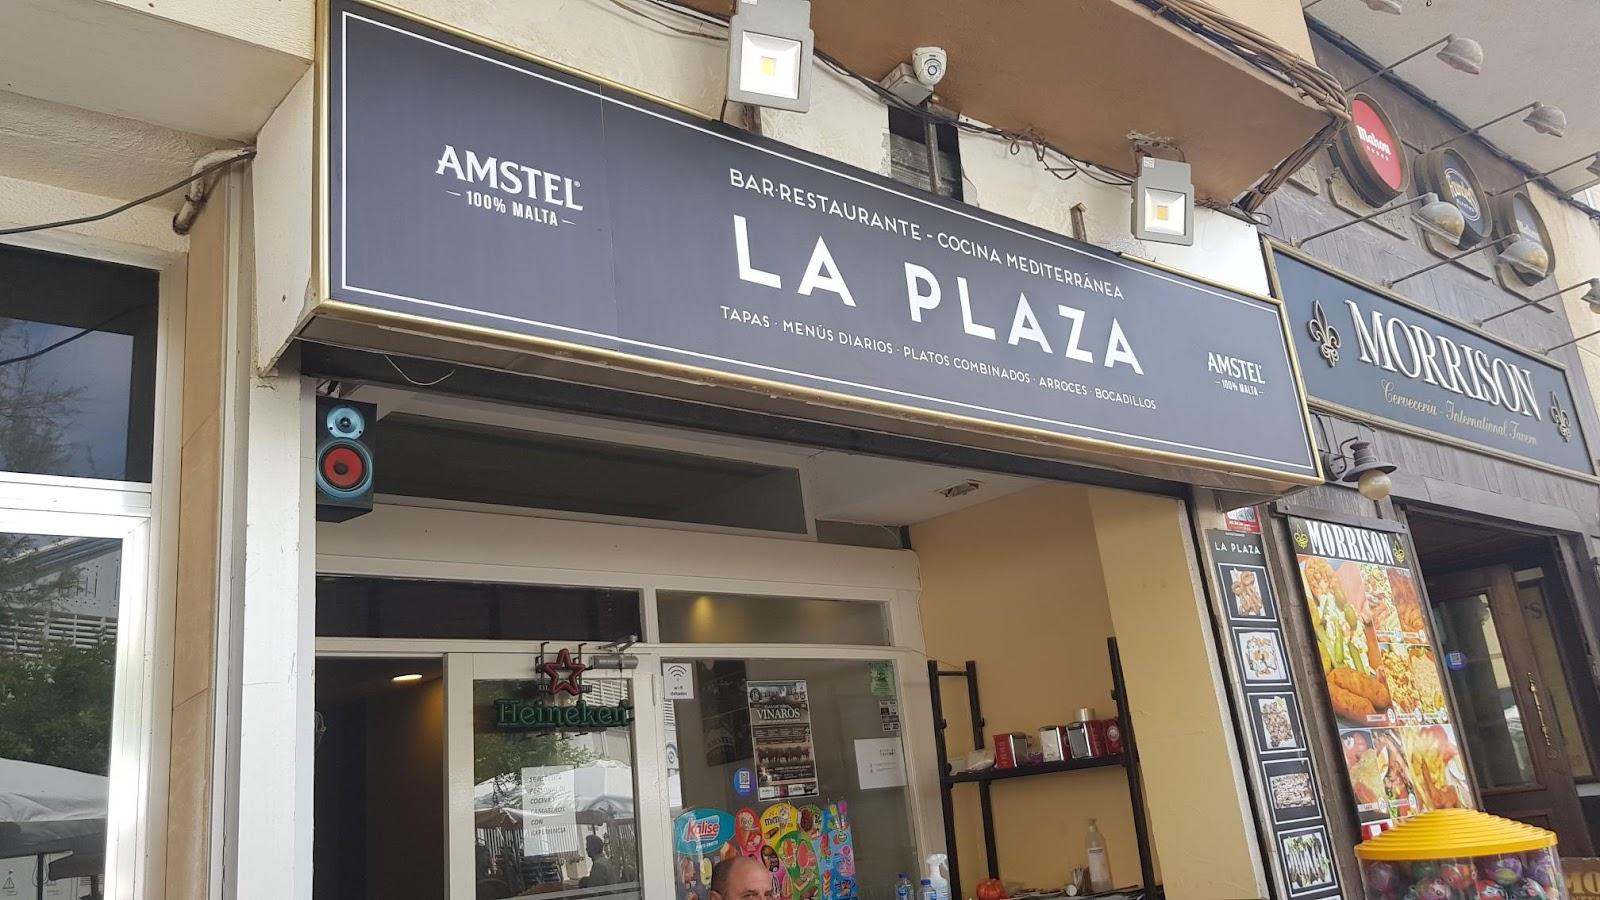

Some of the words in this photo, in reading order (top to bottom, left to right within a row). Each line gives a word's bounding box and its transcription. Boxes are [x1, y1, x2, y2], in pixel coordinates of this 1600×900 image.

[435, 144, 584, 211] AMSTEL
[466, 190, 506, 214] 100%
[512, 201, 558, 226] MALTA
[937, 232, 1002, 265] COCINA
[1006, 252, 1125, 300] MEDITERRÁNEA
[733, 214, 857, 307] LA
[904, 262, 1145, 376] PLAZA
[720, 305, 770, 328] TAPAS
[783, 320, 834, 341] MENÚS
[839, 332, 893, 354] DIARIOS
[903, 346, 950, 367] PLATOS
[953, 357, 1031, 384] COMBINADOS
[1039, 377, 1087, 395] ARROCES
[1094, 388, 1157, 410] BOCADILLOS
[1208, 351, 1266, 385] AMSTEL
[1344, 299, 1542, 422] MORRISON
[1445, 400, 1507, 437] International
[1214, 541, 1228, 552] LA
[1231, 543, 1261, 555] PLAZA
[1305, 520, 1396, 566] MORRISON
[495, 699, 631, 727] Heineken
[686, 820, 719, 839] Kalise
